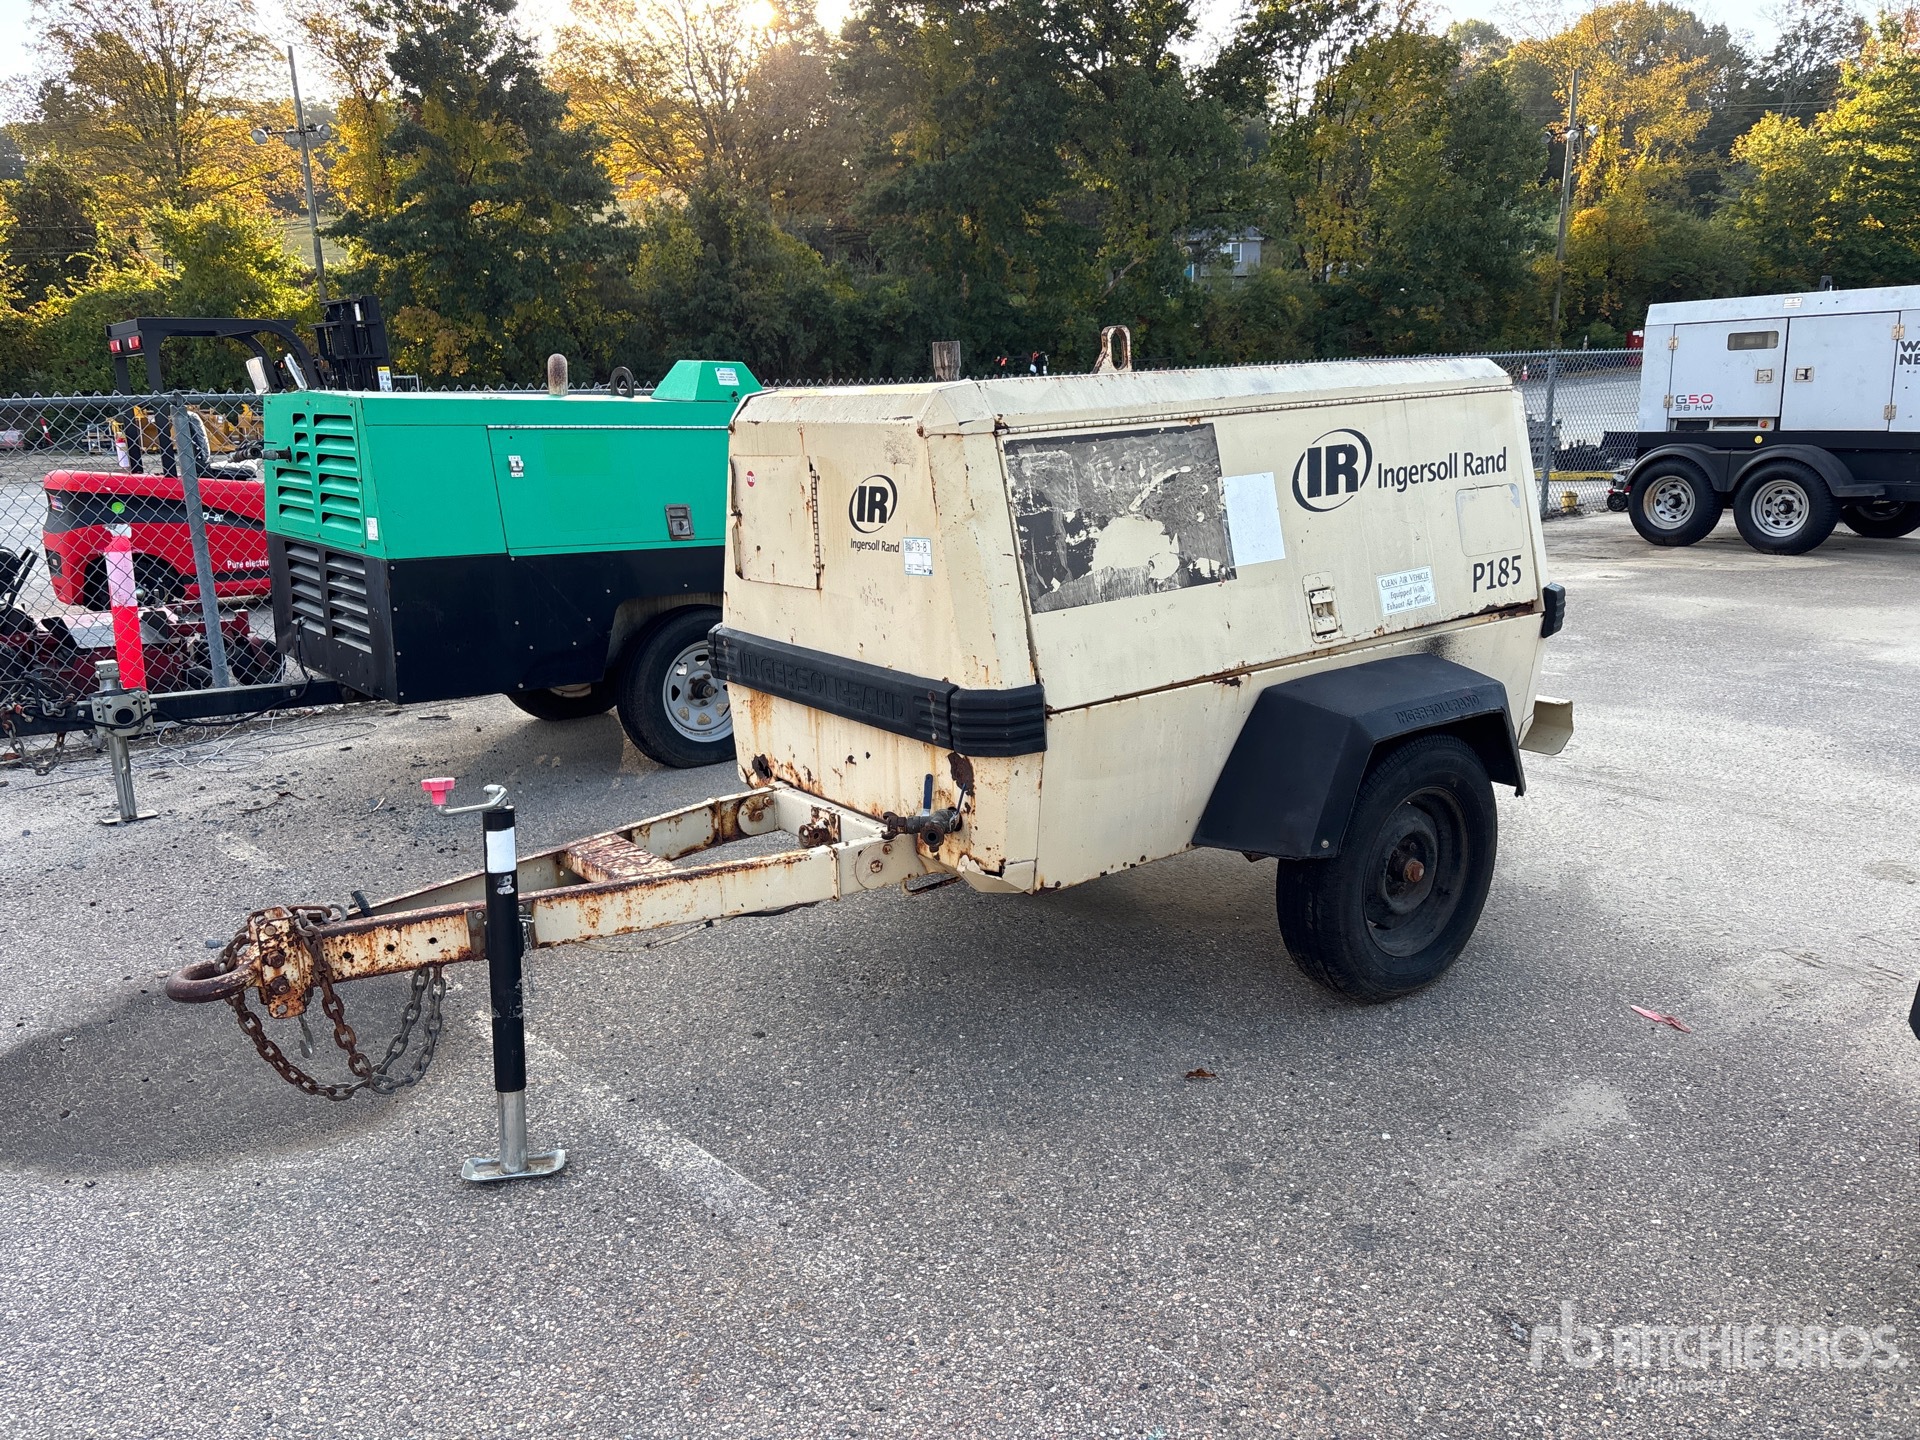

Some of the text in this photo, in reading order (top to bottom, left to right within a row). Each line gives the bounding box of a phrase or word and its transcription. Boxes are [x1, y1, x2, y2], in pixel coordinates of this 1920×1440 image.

[1675, 394, 1714, 404] G50
[1307, 443, 1358, 499] IR
[1378, 446, 1507, 492] Ingersoll Rand
[856, 485, 889, 524] IR
[850, 538, 900, 553] Ingersoll Rand
[227, 560, 244, 569] Pure
[1381, 579, 1397, 588] CLEAN
[1409, 572, 1429, 581] VEHICLE
[1473, 555, 1522, 593] P185
[1390, 587, 1412, 600] Equipped
[1387, 601, 1405, 611] Exhaust
